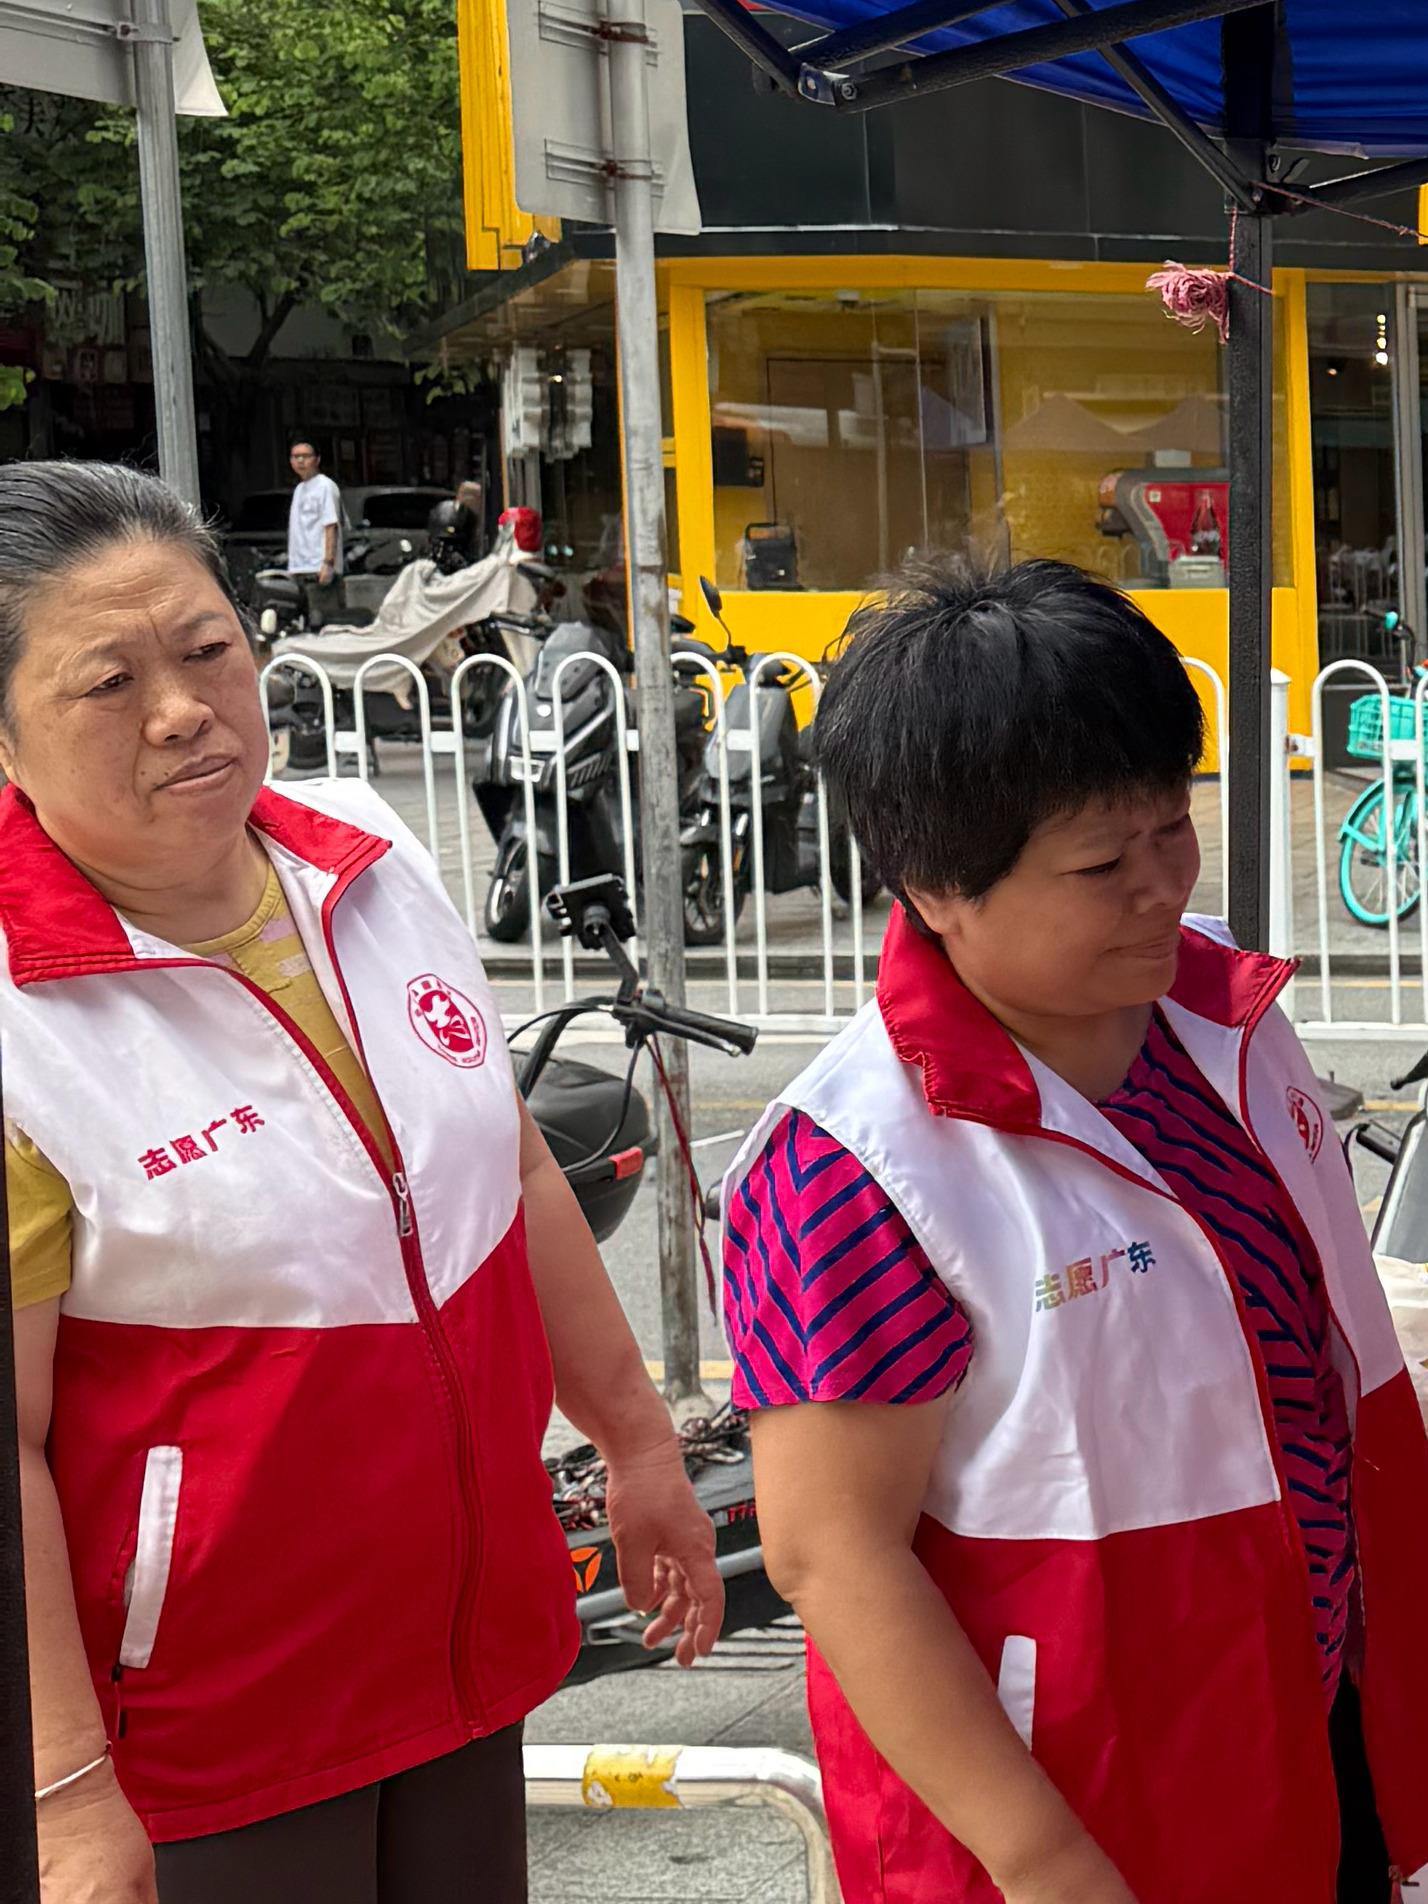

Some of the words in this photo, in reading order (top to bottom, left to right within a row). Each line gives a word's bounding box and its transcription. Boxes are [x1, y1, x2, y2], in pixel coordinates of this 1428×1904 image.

[137, 1104, 266, 1181] 志愿广东
[1035, 1241, 1157, 1313] 志愿广东
